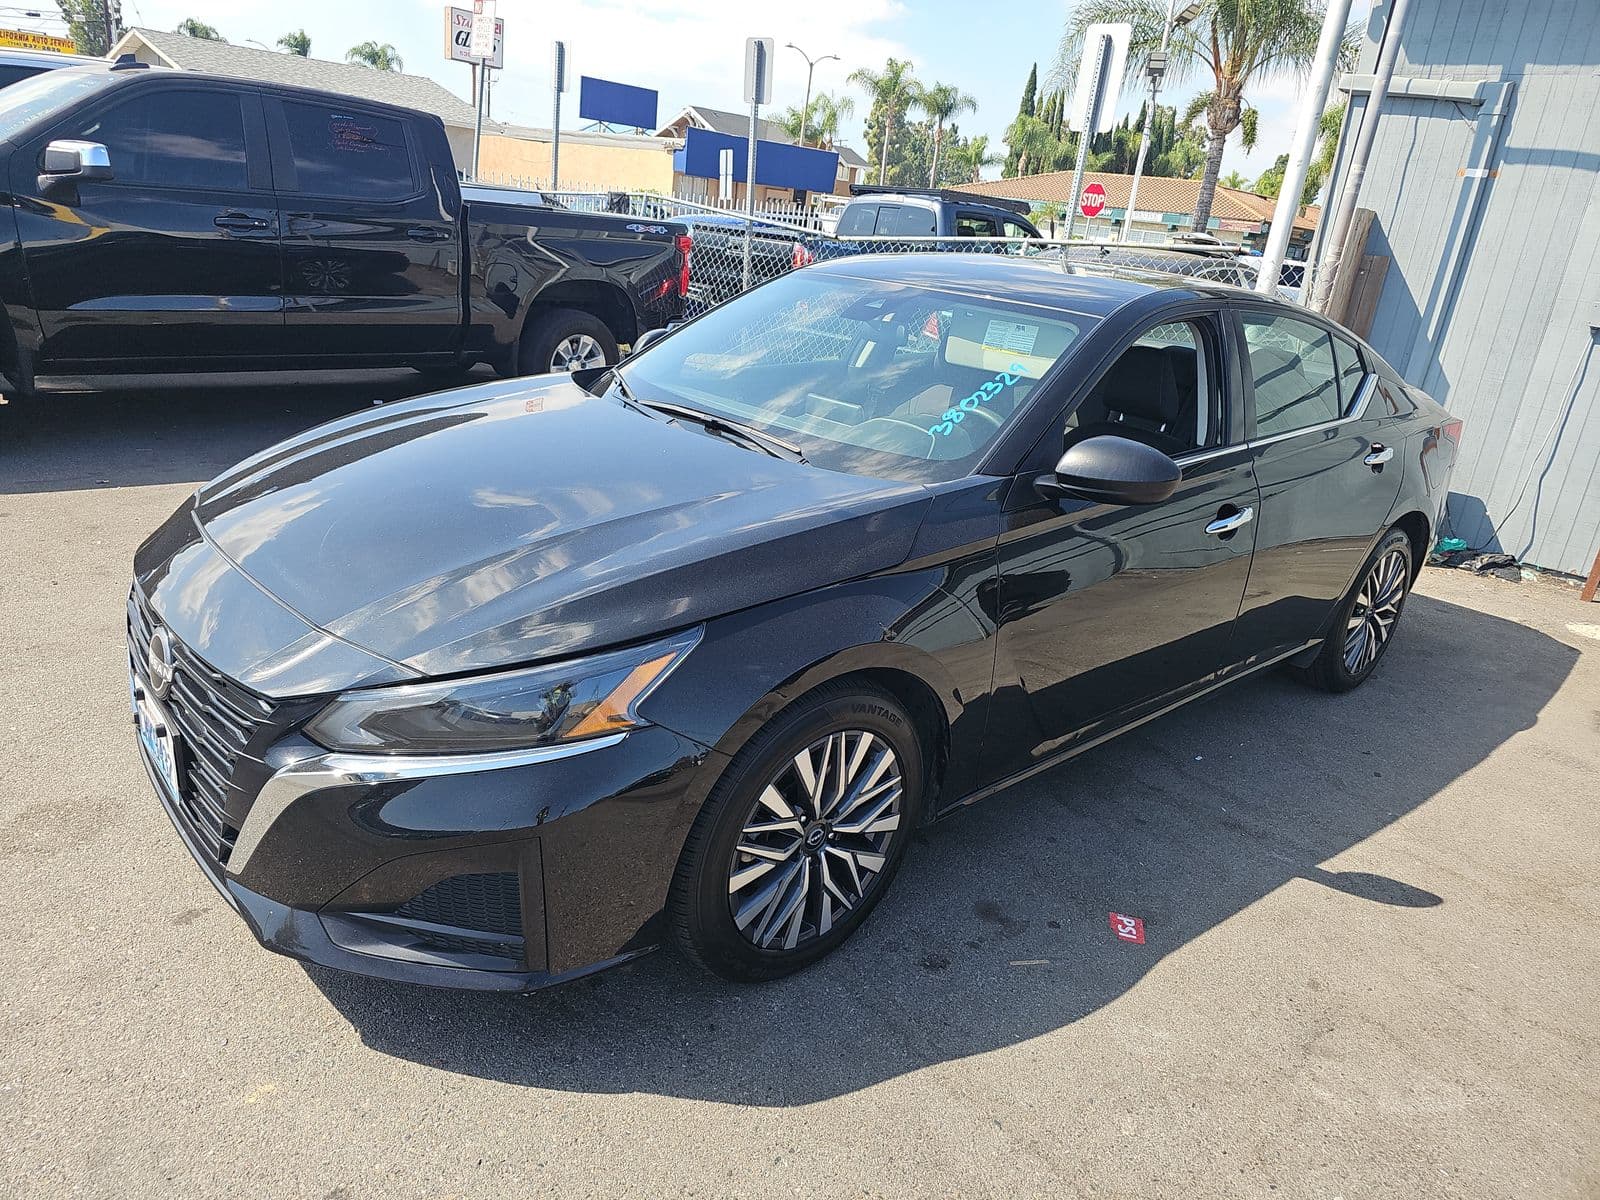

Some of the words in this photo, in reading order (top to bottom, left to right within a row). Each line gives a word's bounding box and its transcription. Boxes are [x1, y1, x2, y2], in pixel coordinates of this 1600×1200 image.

[32, 35, 48, 45] AUTO
[51, 39, 75, 49] SERVICE
[1081, 192, 1105, 208] STOP
[928, 362, 1029, 435] 3802329
[851, 703, 904, 728] VANTAGE
